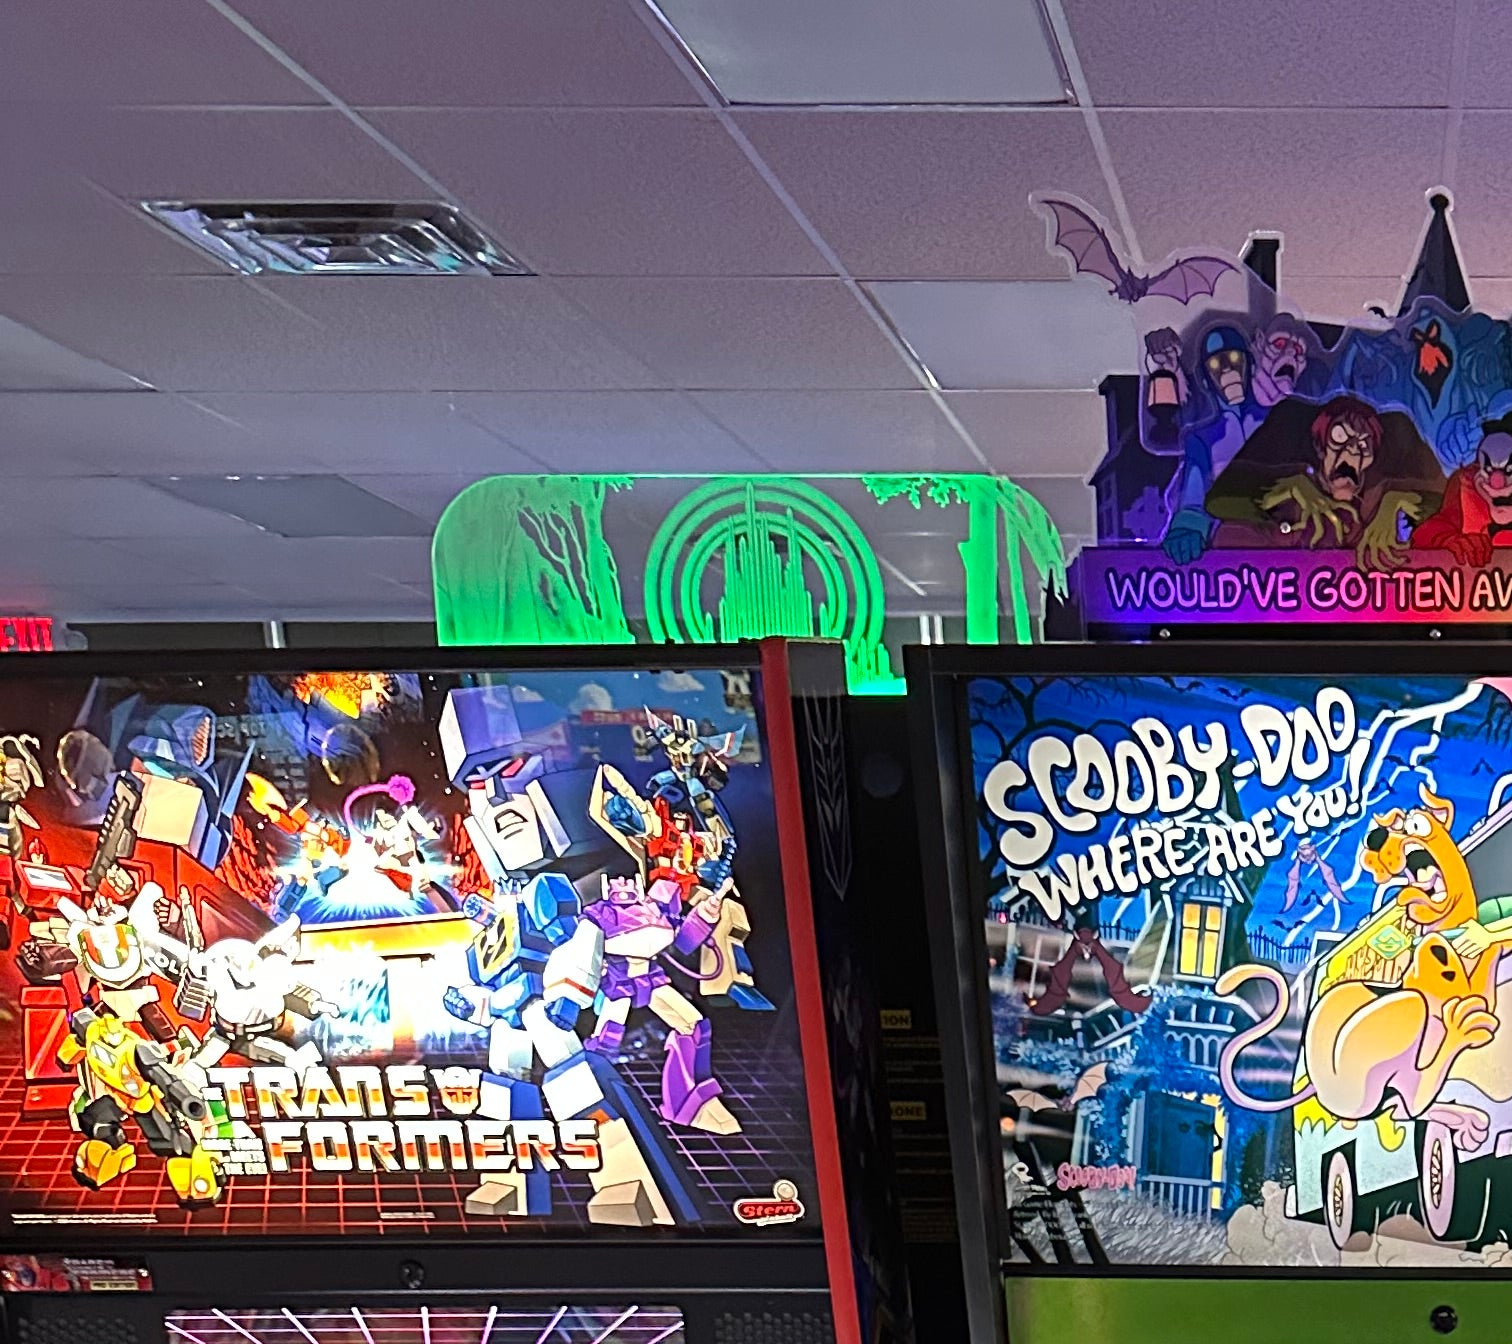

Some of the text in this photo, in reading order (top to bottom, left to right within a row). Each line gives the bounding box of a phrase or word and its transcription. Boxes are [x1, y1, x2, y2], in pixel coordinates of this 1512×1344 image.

[1106, 569, 1299, 611] WOULD'VE
[1308, 569, 1463, 610] GOTTEN
[0, 616, 53, 652] EXIT
[1018, 737, 1372, 922] WHERE ARE YOU!
[205, 1065, 430, 1118] TRANS
[260, 1119, 601, 1174] FORMERS
[742, 1204, 796, 1217] Stern
